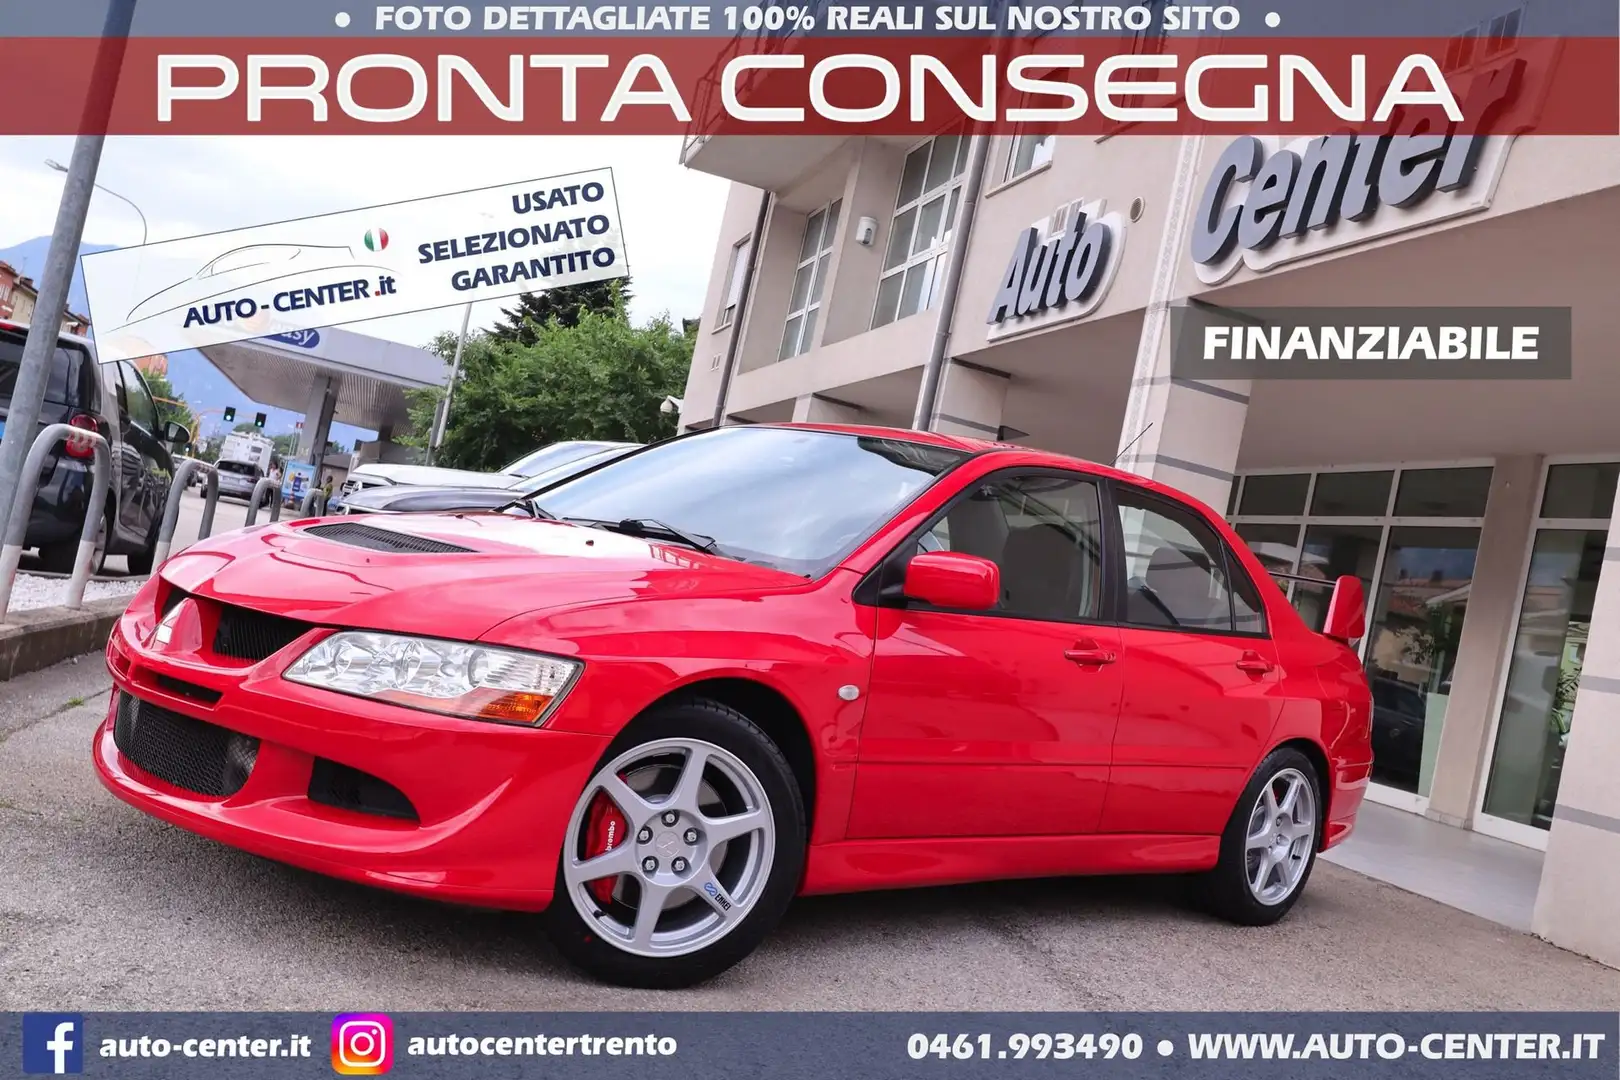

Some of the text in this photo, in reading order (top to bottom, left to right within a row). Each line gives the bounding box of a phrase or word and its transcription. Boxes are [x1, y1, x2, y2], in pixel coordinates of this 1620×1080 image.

[1191, 58, 1526, 266] Center
[986, 210, 1111, 325] Auto
[605, 821, 615, 851] brembo
